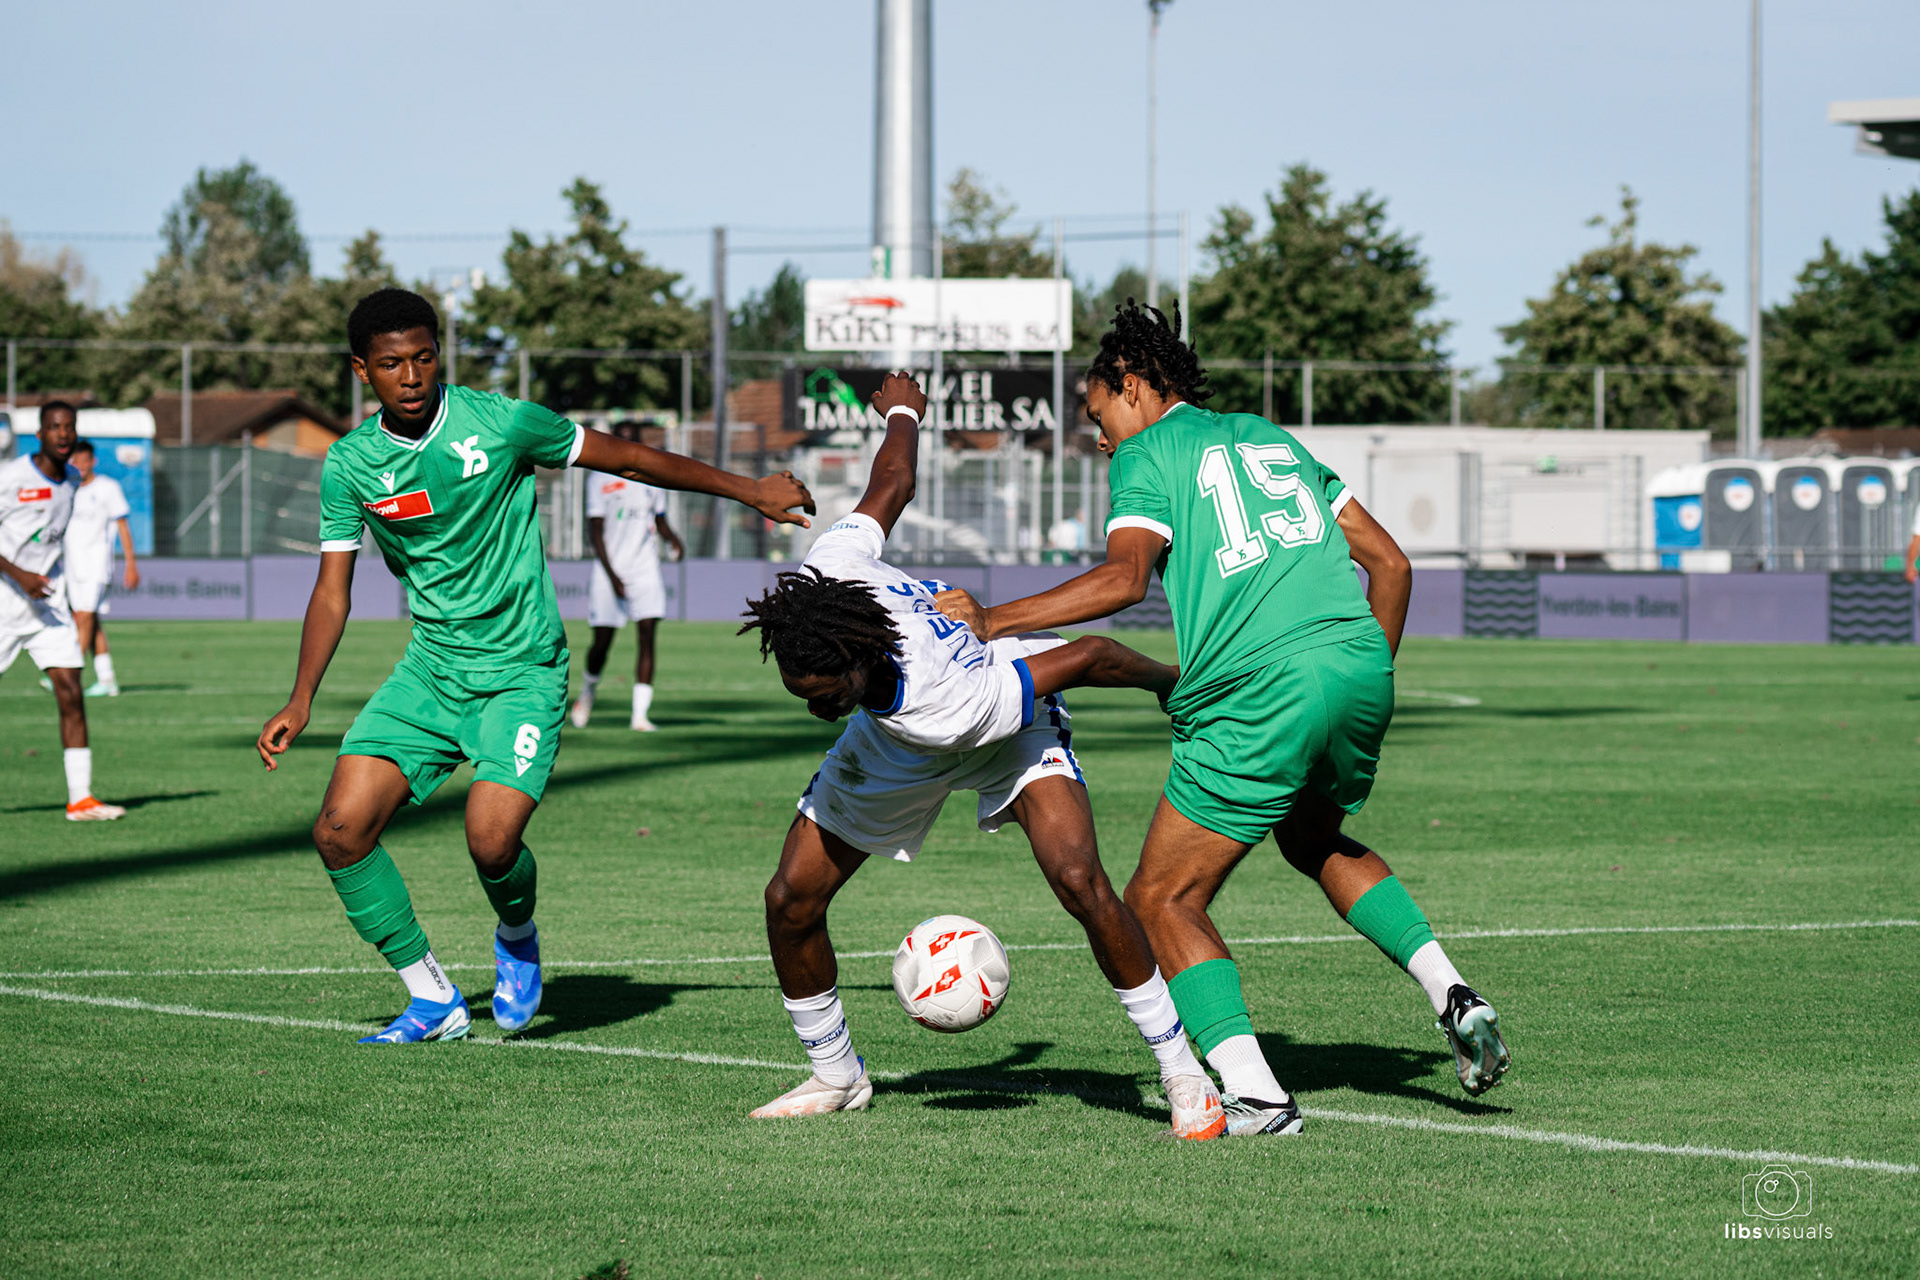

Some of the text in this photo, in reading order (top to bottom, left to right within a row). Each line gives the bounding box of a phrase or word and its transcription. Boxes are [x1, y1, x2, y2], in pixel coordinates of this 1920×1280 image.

[1023, 321, 1063, 344] SA
[797, 396, 1057, 431] IMMILIER SA
[1196, 442, 1325, 579] 15
[513, 723, 541, 759] 6
[1265, 1112, 1288, 1133] MESSI
